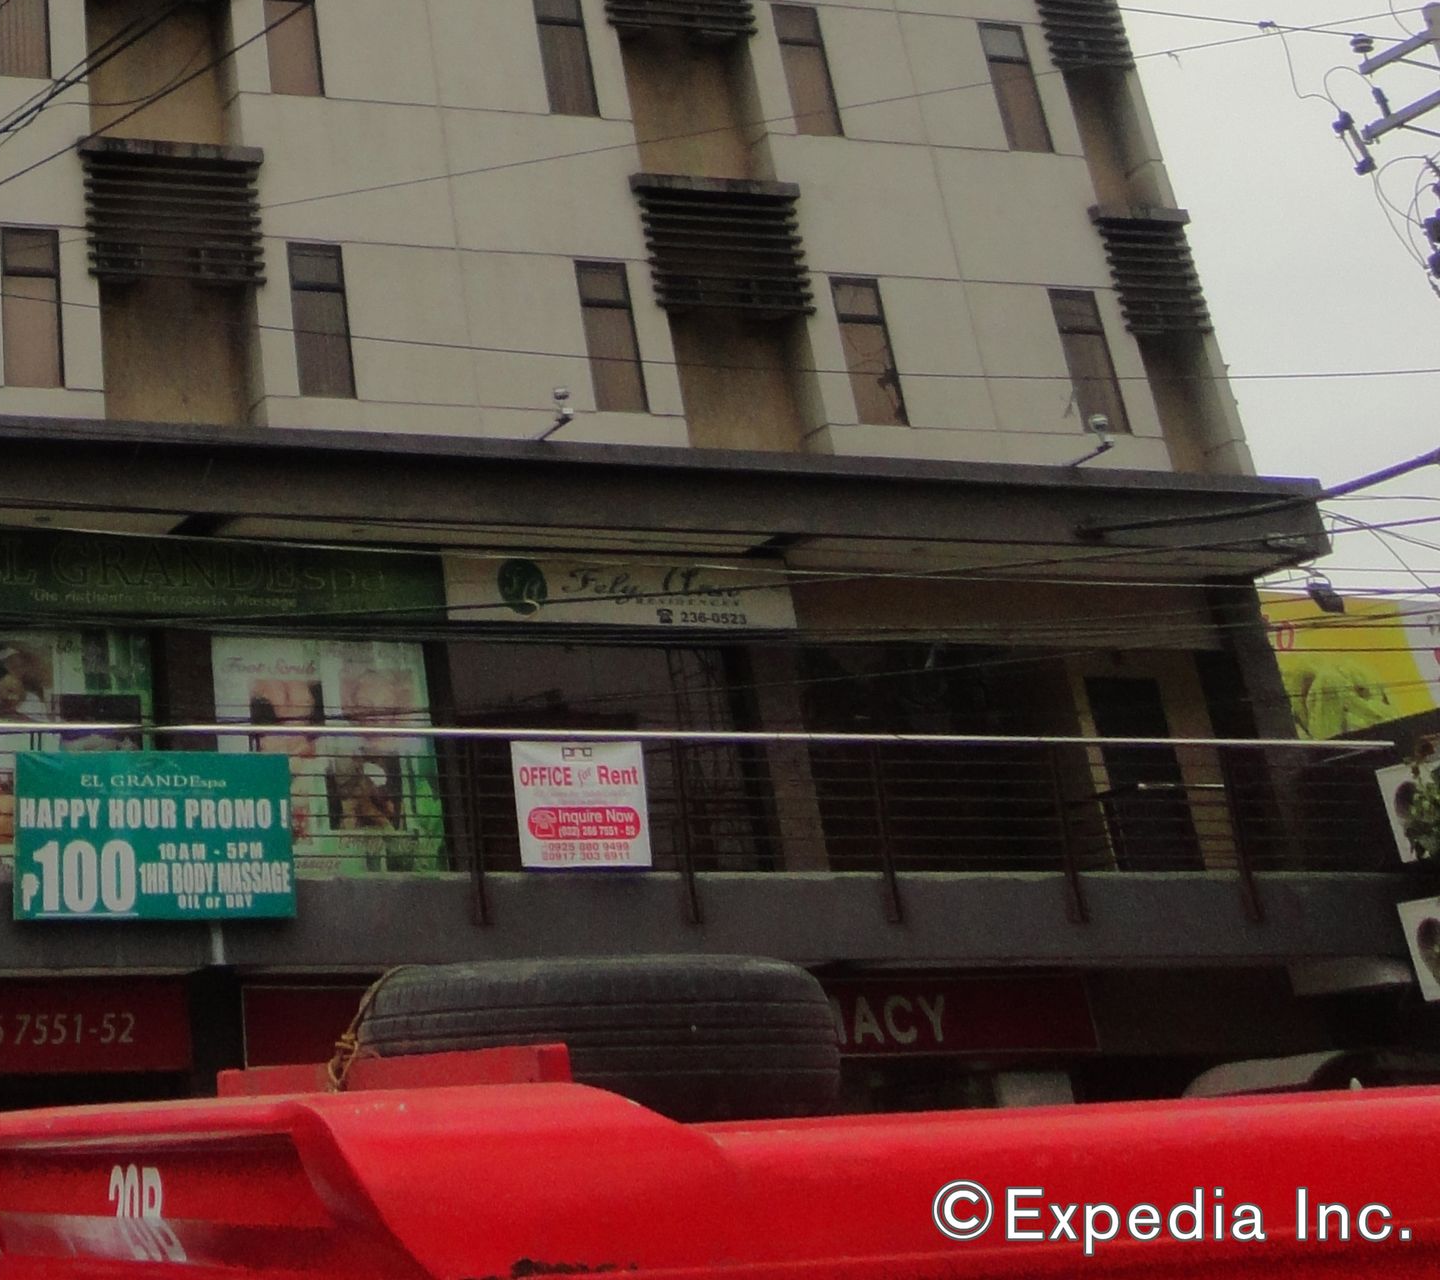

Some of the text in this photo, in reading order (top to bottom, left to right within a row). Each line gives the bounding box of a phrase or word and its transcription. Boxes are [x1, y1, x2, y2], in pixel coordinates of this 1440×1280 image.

[680, 612, 748, 625] 236-0523
[80, 774, 104, 788] EL
[519, 766, 573, 787] OFFICE
[596, 765, 639, 786] Rent
[19, 797, 101, 829] HAPPY
[108, 798, 177, 829] HOUR
[185, 798, 273, 829] PROMO
[558, 809, 635, 825] Inquire Now
[158, 843, 207, 860] 10AM
[226, 842, 263, 859] 5PM
[139, 862, 292, 894] 1HR BODY MASSAGE
[177, 894, 201, 909] OIL
[226, 894, 254, 908] DRY
[13, 1013, 136, 1045] 7551-52
